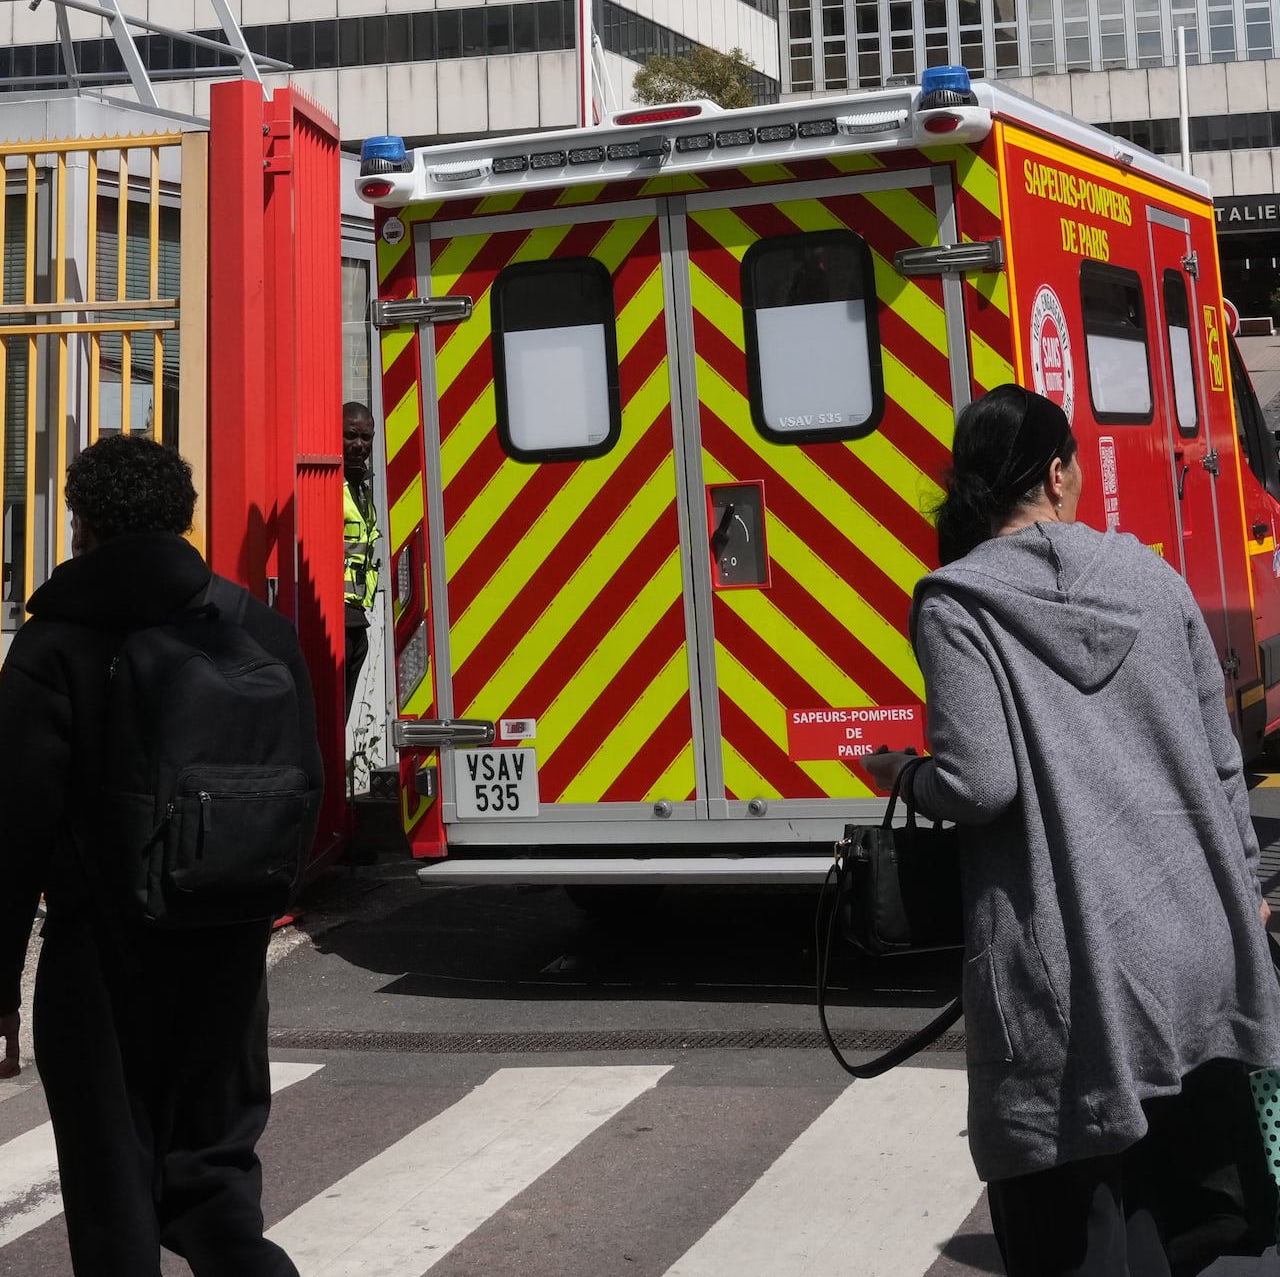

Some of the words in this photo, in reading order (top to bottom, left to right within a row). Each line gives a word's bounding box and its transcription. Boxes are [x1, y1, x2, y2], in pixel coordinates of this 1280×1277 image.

[1023, 158, 1132, 227] SAPEURS-POMPIERS
[1060, 217, 1079, 254] DE
[1078, 223, 1110, 262] PARIS
[1042, 336, 1062, 369] SANS
[778, 415, 813, 428] VSAV
[818, 412, 842, 424] 535
[793, 709, 914, 724] SAPEURS-POMPIERS
[845, 727, 863, 739] DE
[838, 744, 873, 757] PARIS
[466, 753, 525, 781] VSAV
[475, 784, 520, 812] 535
